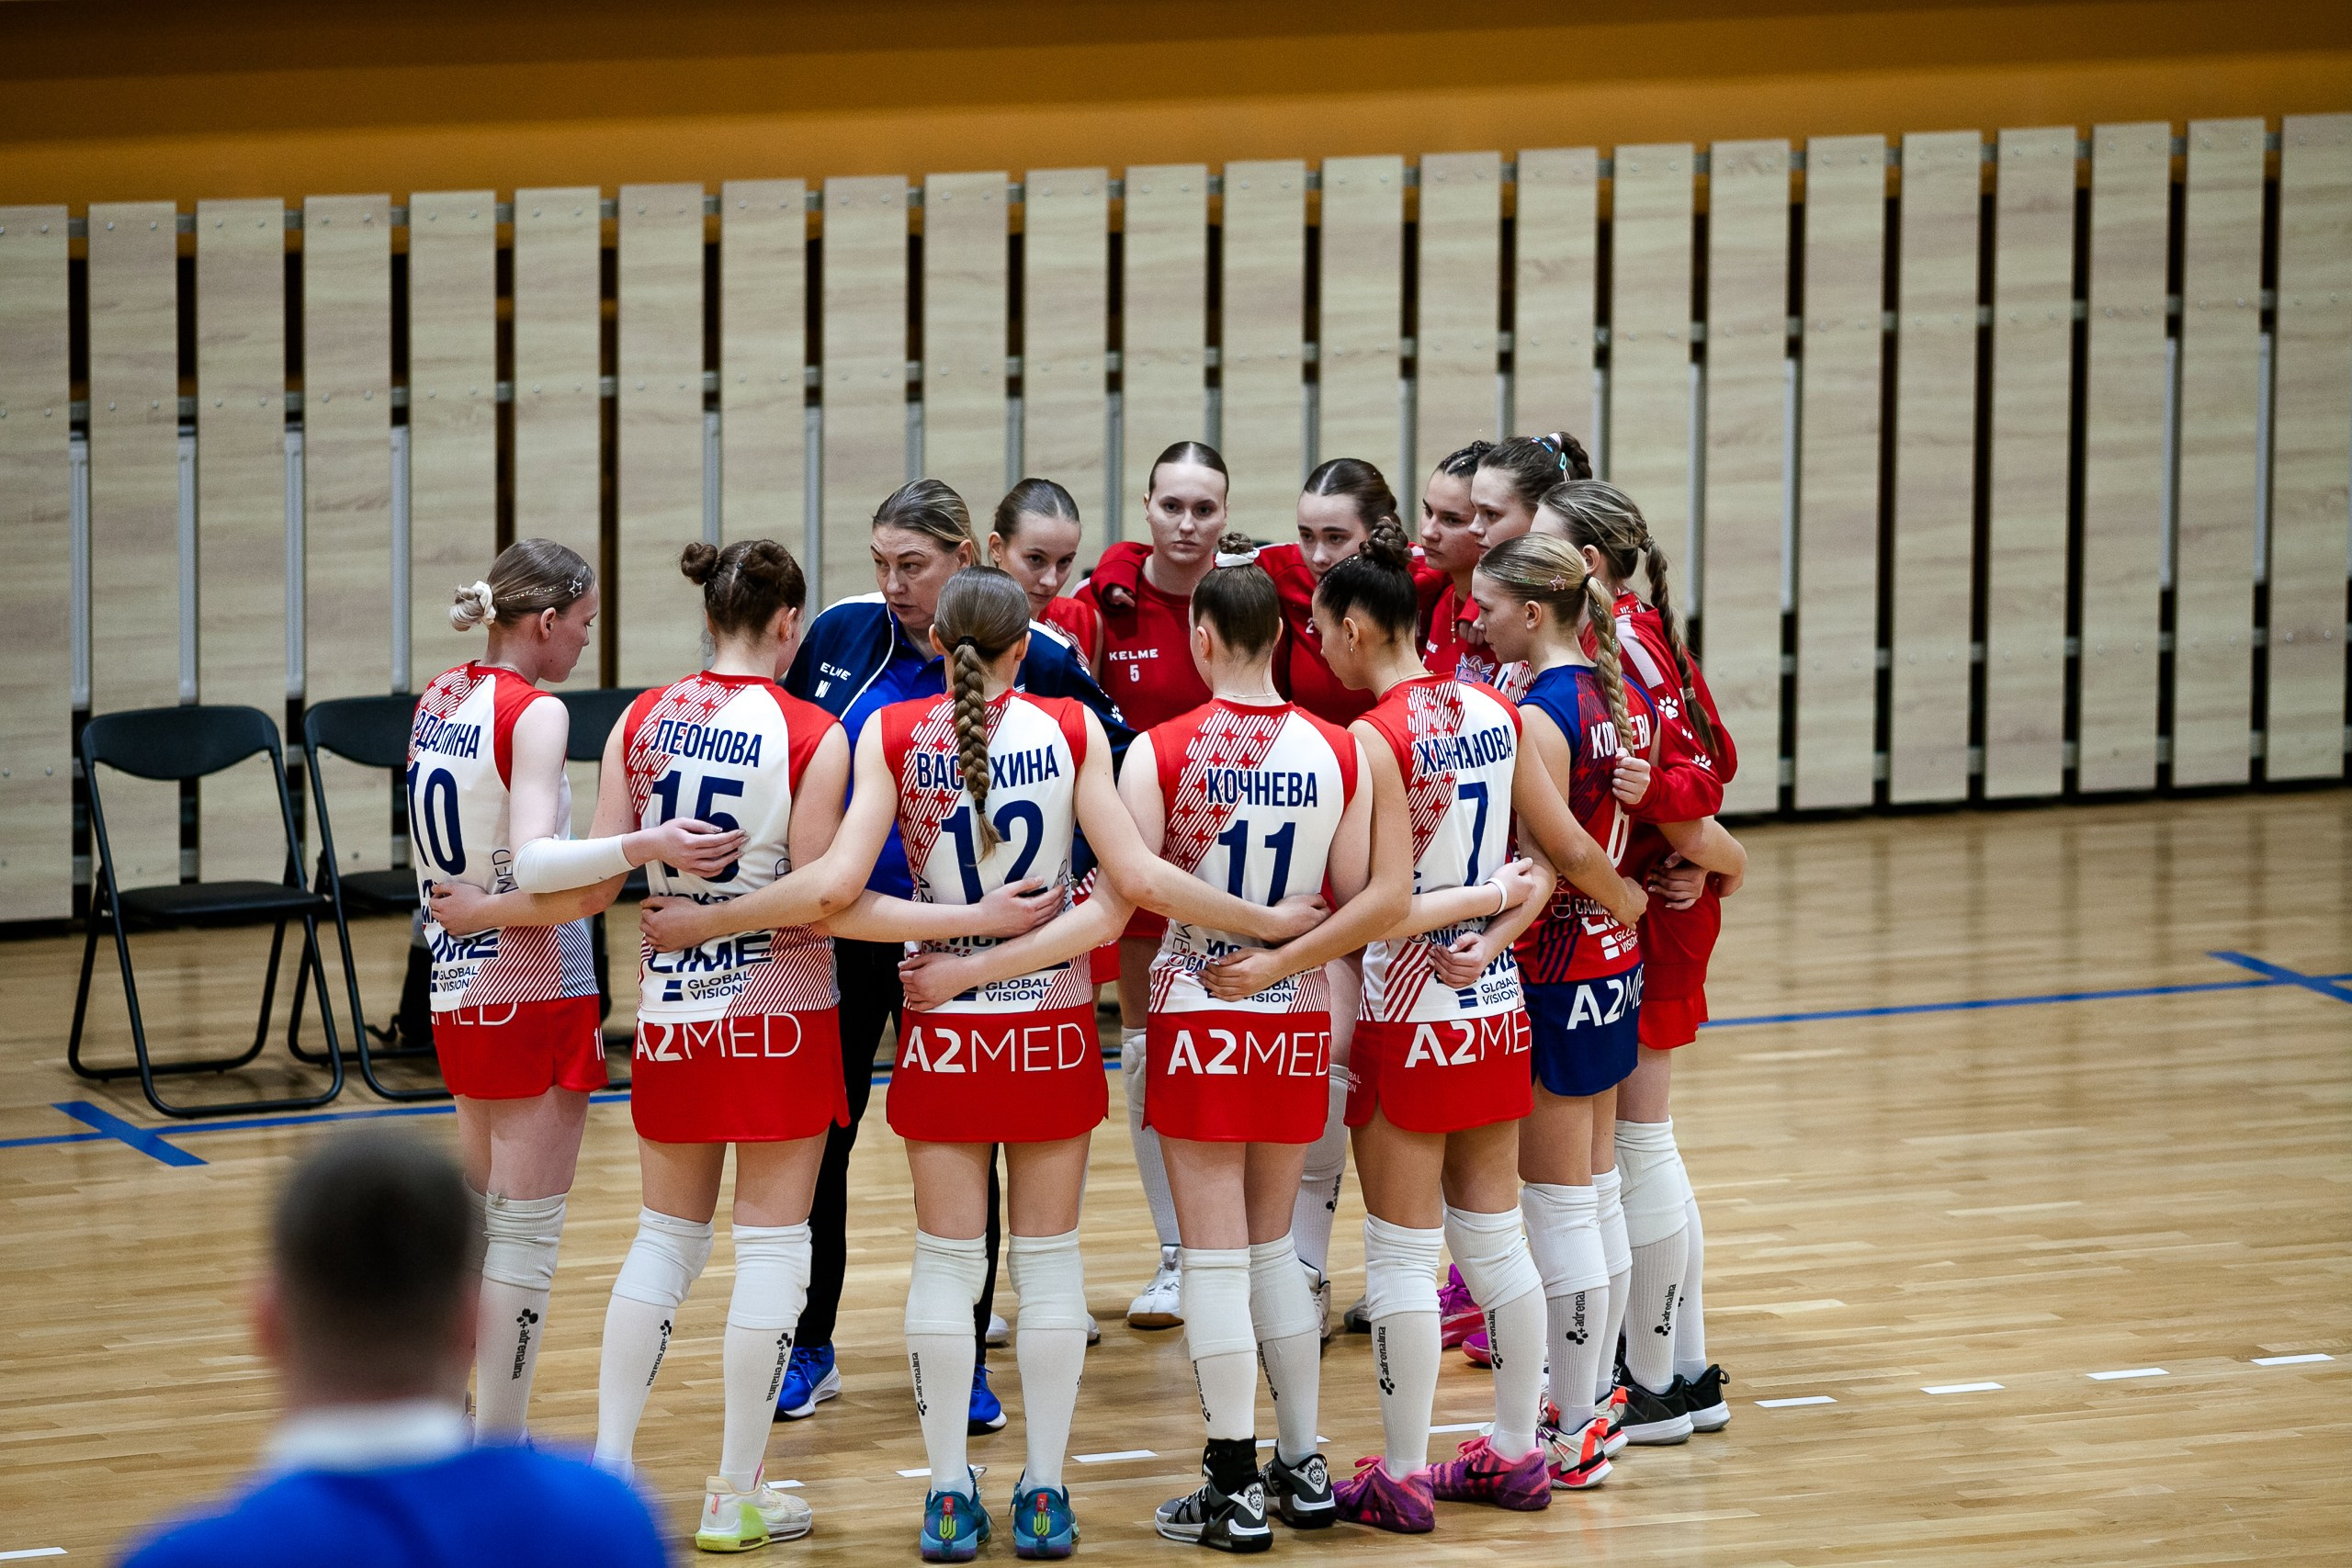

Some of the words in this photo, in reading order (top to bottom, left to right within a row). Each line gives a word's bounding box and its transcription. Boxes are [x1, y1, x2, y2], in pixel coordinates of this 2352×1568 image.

[1109, 649, 1159, 660] KELME
[1129, 664, 1140, 682] 5
[650, 719, 762, 768] ЛЕОНОВА
[916, 744, 1060, 791] ВАСХИНА
[1206, 768, 1318, 808] КОЧНЕВА
[406, 761, 467, 876] 10
[651, 770, 744, 883] 15
[1458, 782, 1488, 886] 7
[941, 800, 1048, 905] 12
[1217, 819, 1296, 907] 11
[438, 965, 478, 980] GLOBAL
[439, 978, 470, 992] VISION
[687, 971, 752, 989] GLOBAL
[690, 985, 744, 999] VISION
[985, 978, 1053, 990] GLOBAL
[985, 989, 1045, 1002] VISION
[1480, 976, 1519, 994] GLOBAL
[1244, 993, 1293, 1003] ISION
[1482, 988, 1519, 1005] VISION
[1566, 964, 1645, 1030] A2ME
[636, 1011, 802, 1062] A2MED
[902, 1022, 1086, 1073] A2MED
[1167, 1029, 1330, 1077] A2MED
[1405, 1008, 1532, 1068] A2ME
[511, 1329, 531, 1380] adrenalina
[1376, 1325, 1390, 1376] adrenalina
[766, 1352, 786, 1402] adrenalina
[911, 1351, 923, 1398] adrenalina
